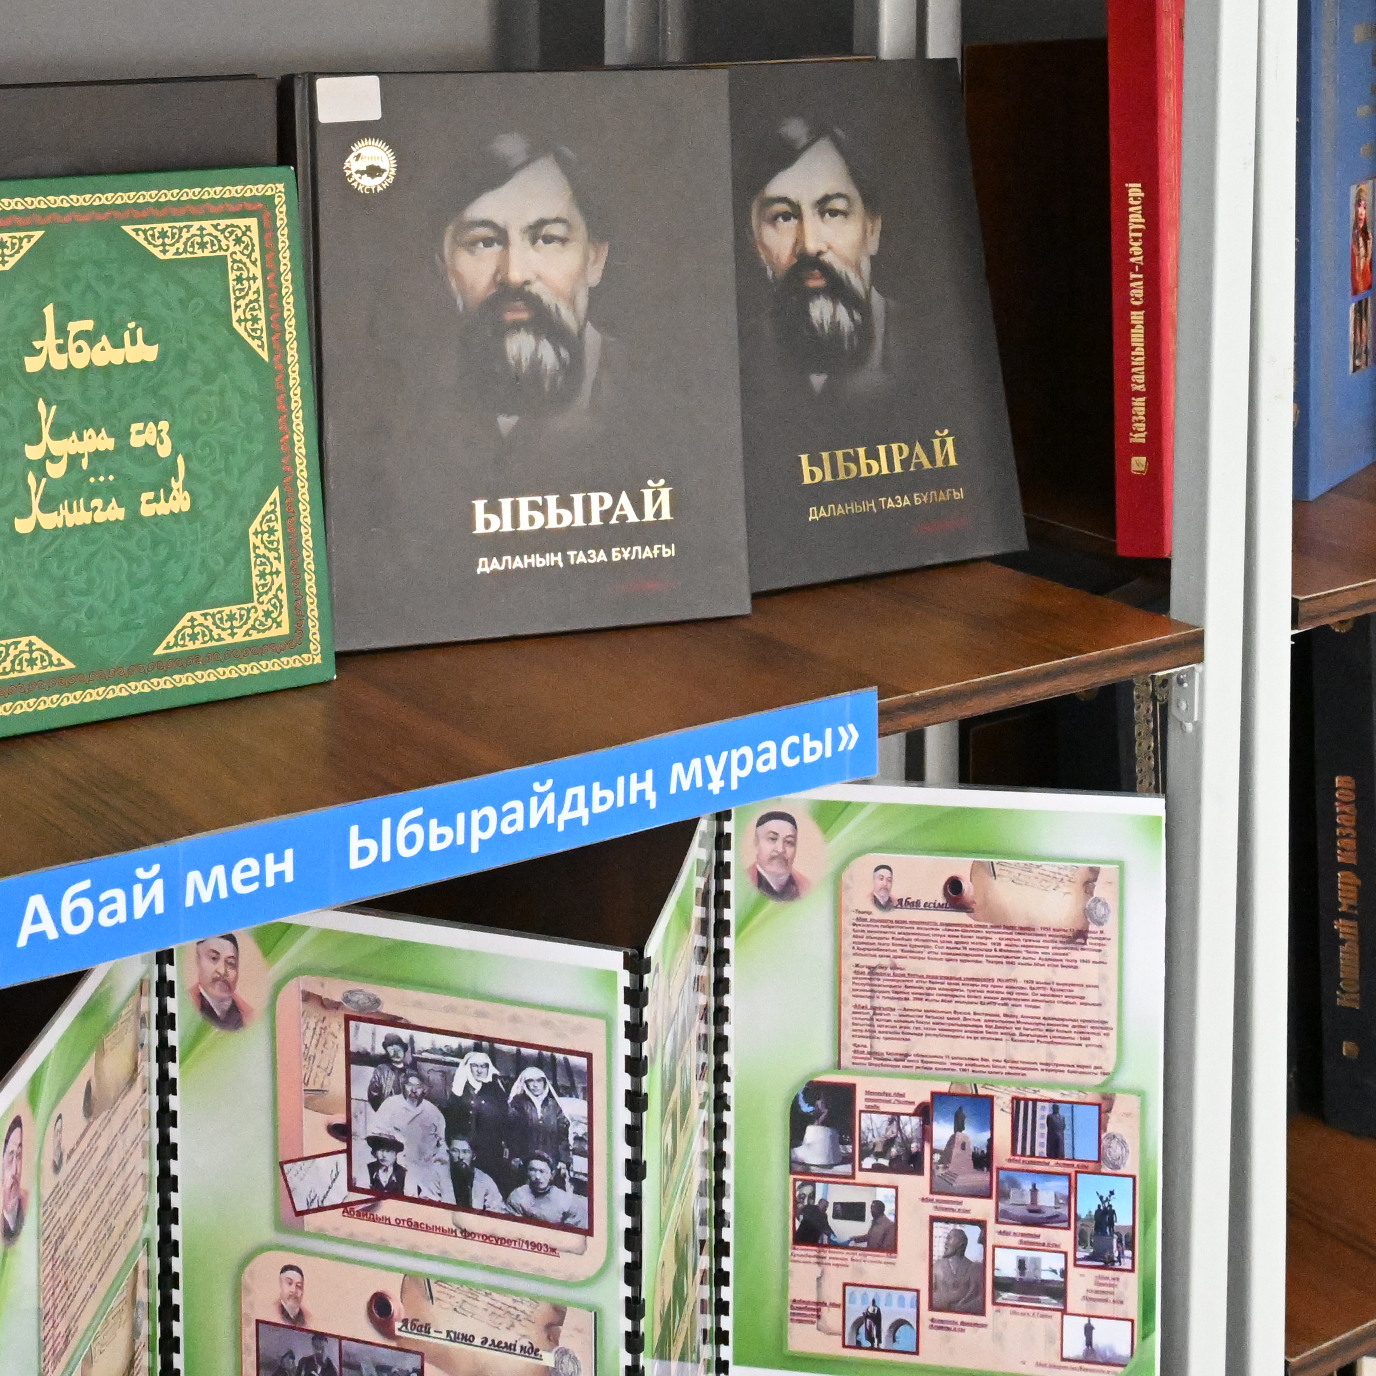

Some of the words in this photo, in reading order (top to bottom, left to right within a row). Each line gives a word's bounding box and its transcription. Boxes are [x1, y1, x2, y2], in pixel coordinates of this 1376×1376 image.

[23, 302, 160, 372] Абай
[1128, 310, 1147, 392] халқының
[1129, 397, 1147, 443] Қазақ
[796, 428, 959, 486] ЫБЫРАЙ
[14, 470, 125, 534] Книга
[139, 454, 191, 518] слов
[471, 478, 674, 535] ЫБЫРАЙ
[807, 498, 878, 523] ДАЛАНЫҢ
[879, 494, 912, 511] ТАЗА
[913, 486, 965, 507] БҰЛАҒЫ
[476, 549, 564, 575] ДАЛАНЫҢ
[567, 548, 608, 567] ТАЗА
[611, 543, 676, 563] БҰЛАҒЫ
[16, 863, 166, 949] Абай
[184, 846, 295, 908] мен
[347, 768, 658, 871] Ыбырайдың
[669, 720, 861, 798] мұрасы»
